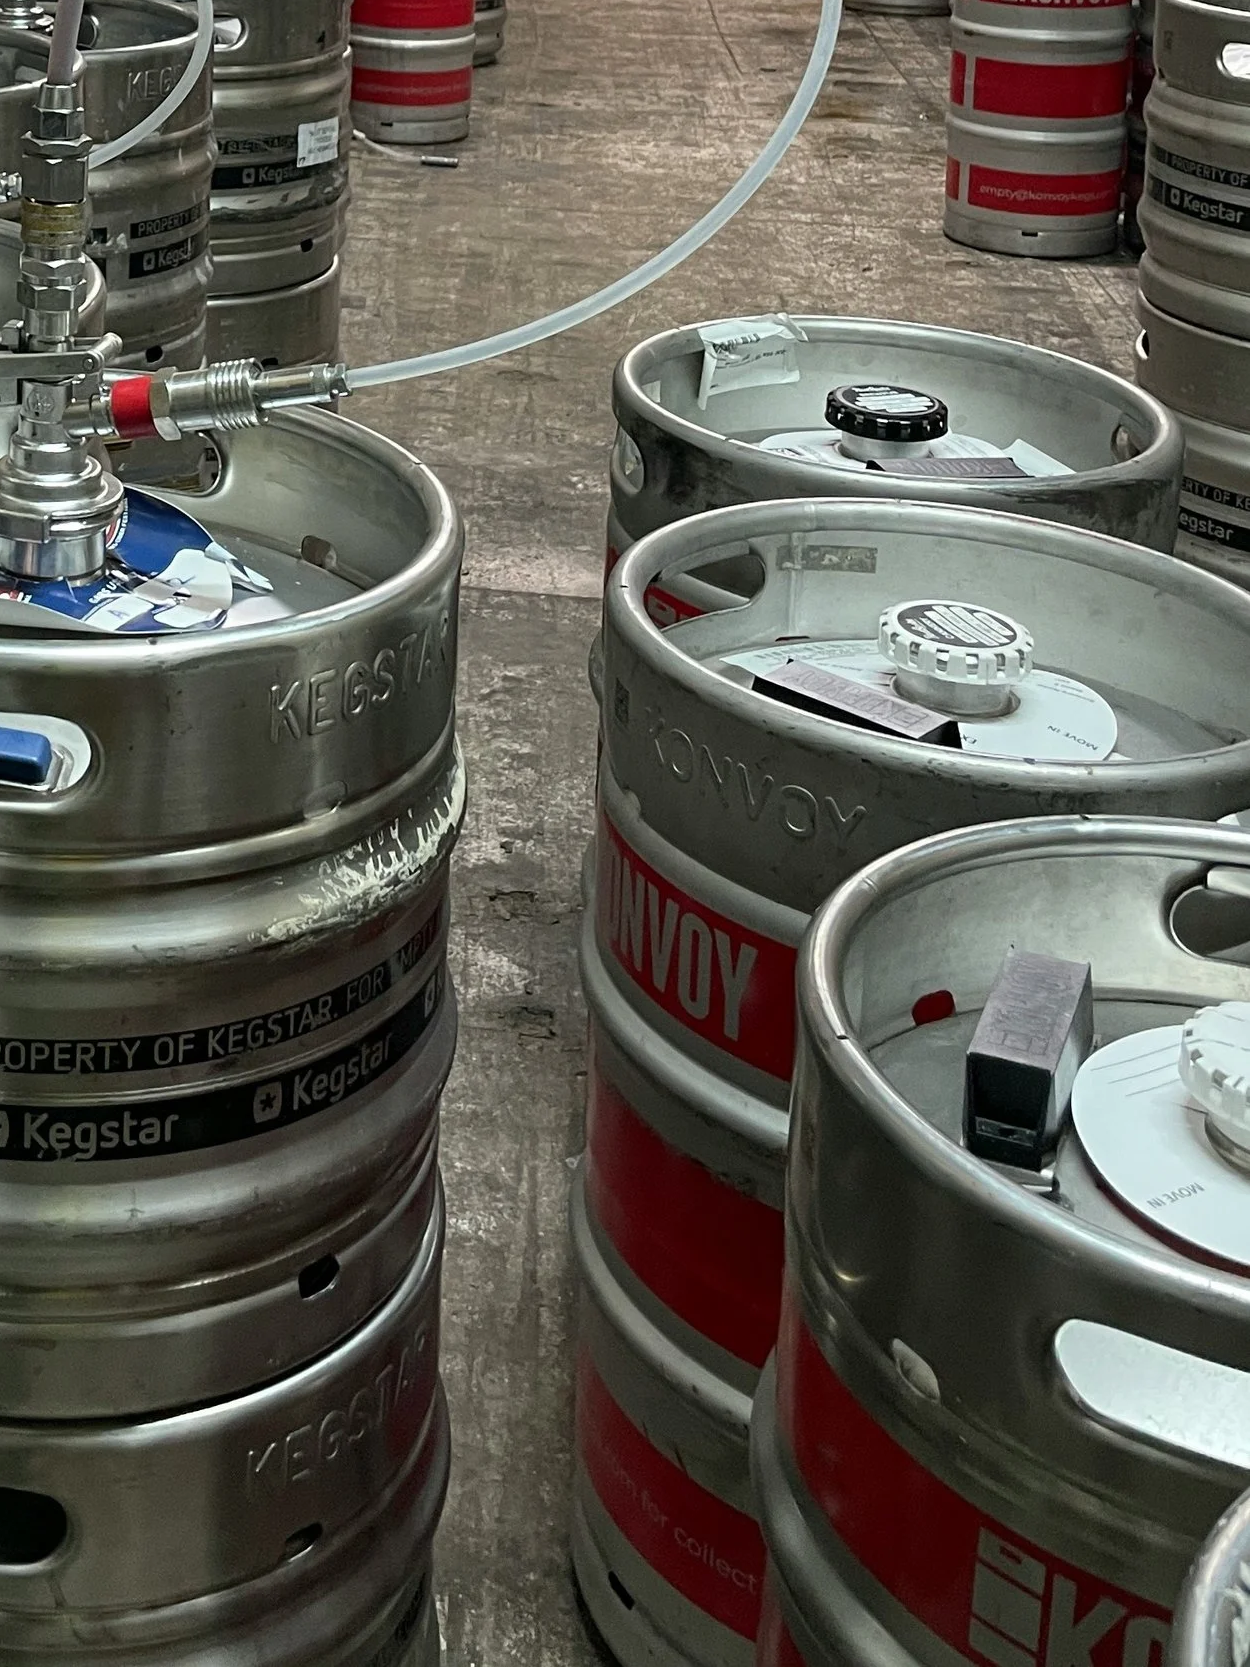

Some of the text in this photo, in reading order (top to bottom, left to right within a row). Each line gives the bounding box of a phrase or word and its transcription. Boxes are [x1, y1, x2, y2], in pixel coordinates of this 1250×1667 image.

[1183, 193, 1245, 224] Kegstar
[1179, 512, 1234, 541] egstar
[153, 1033, 196, 1067] OF
[346, 965, 386, 1004] FOR
[292, 1032, 394, 1111] Kegstar
[23, 1111, 180, 1161] Kegstar
[1147, 1182, 1205, 1209] MOVE IN
[673, 1526, 757, 1594] collect
